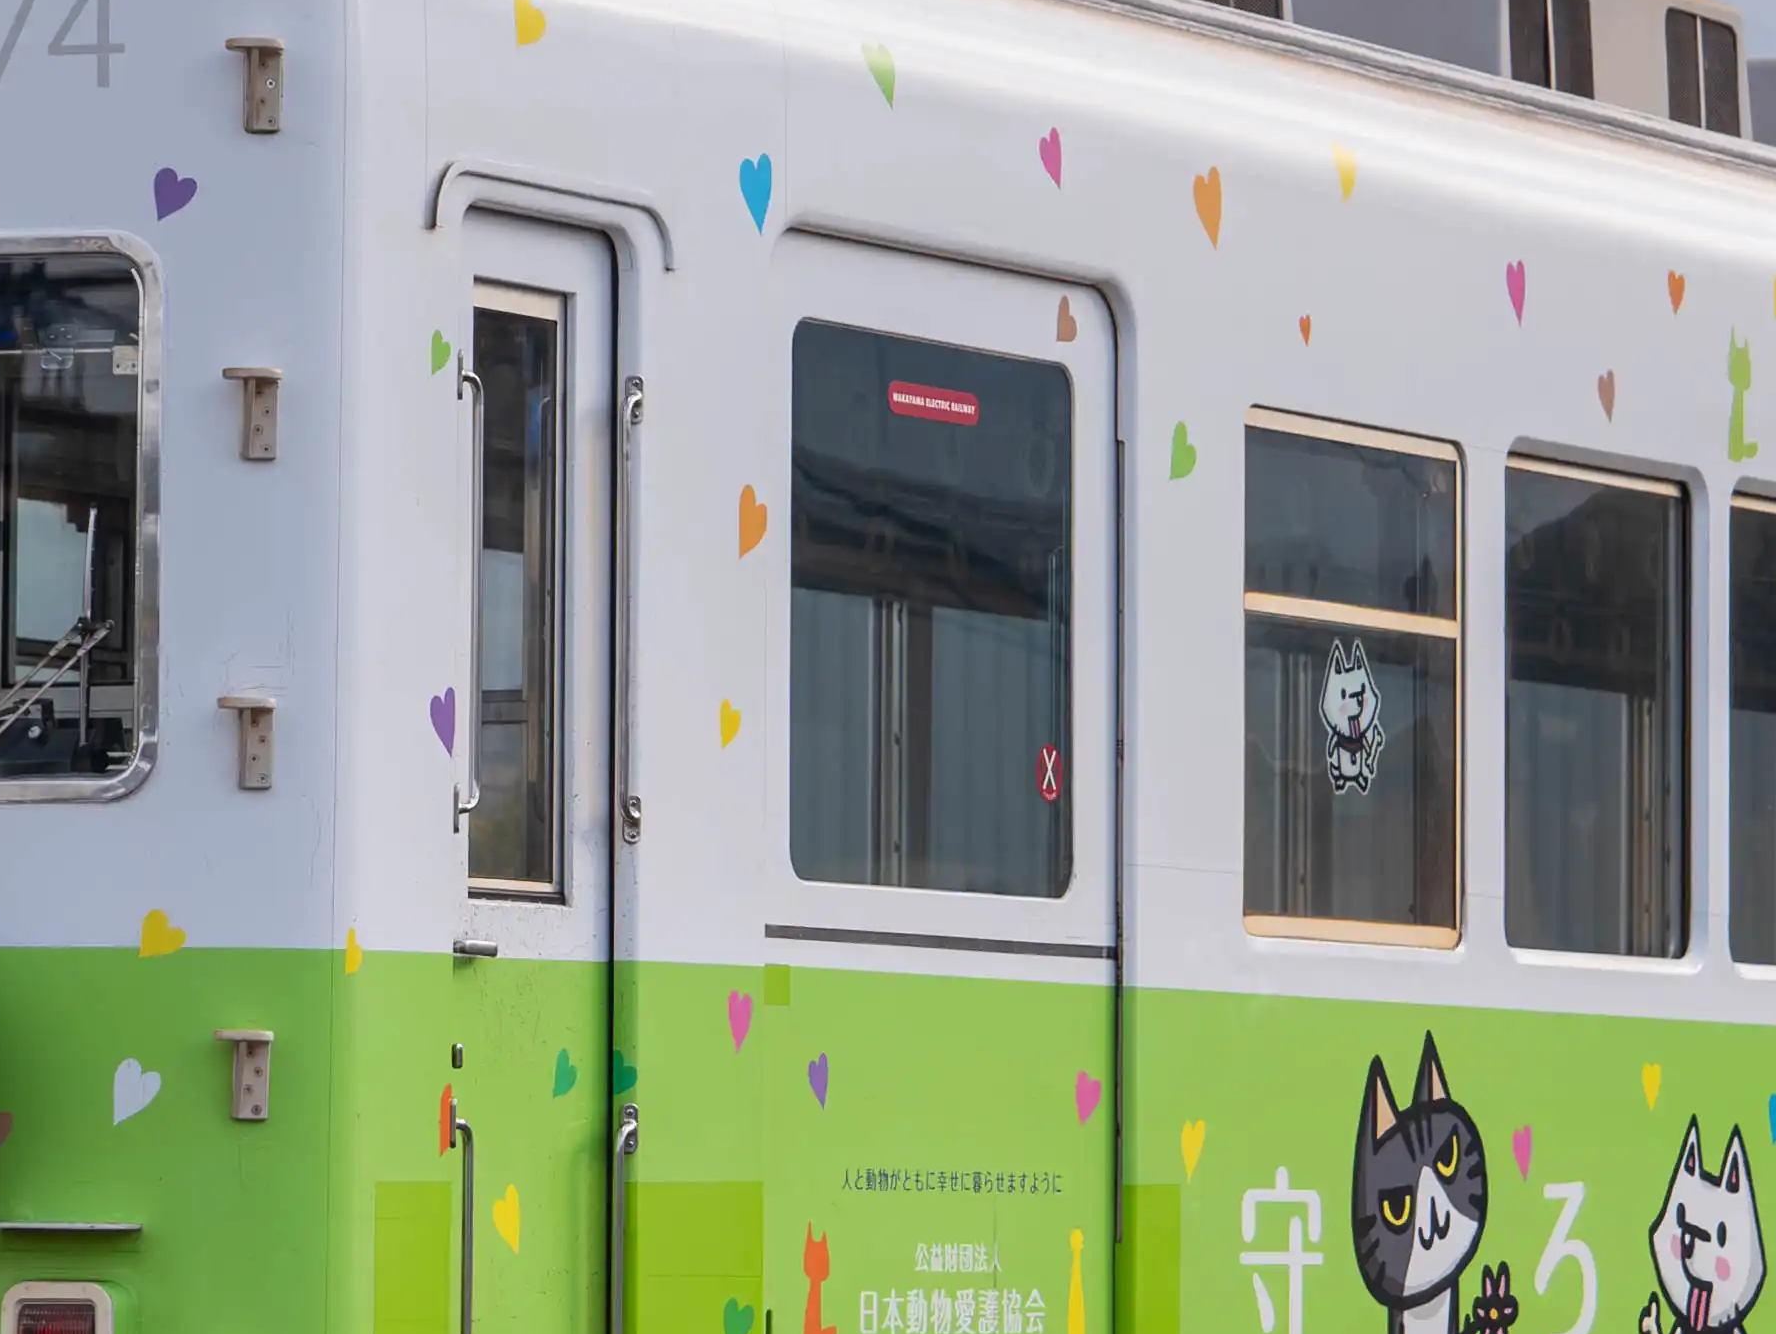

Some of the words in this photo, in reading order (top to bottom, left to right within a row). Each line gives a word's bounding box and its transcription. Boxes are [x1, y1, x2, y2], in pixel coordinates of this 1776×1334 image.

[842, 1168, 1063, 1195] 人と動物がともに幸せに暮らせますように
[914, 1242, 1002, 1273] 公益財団法人
